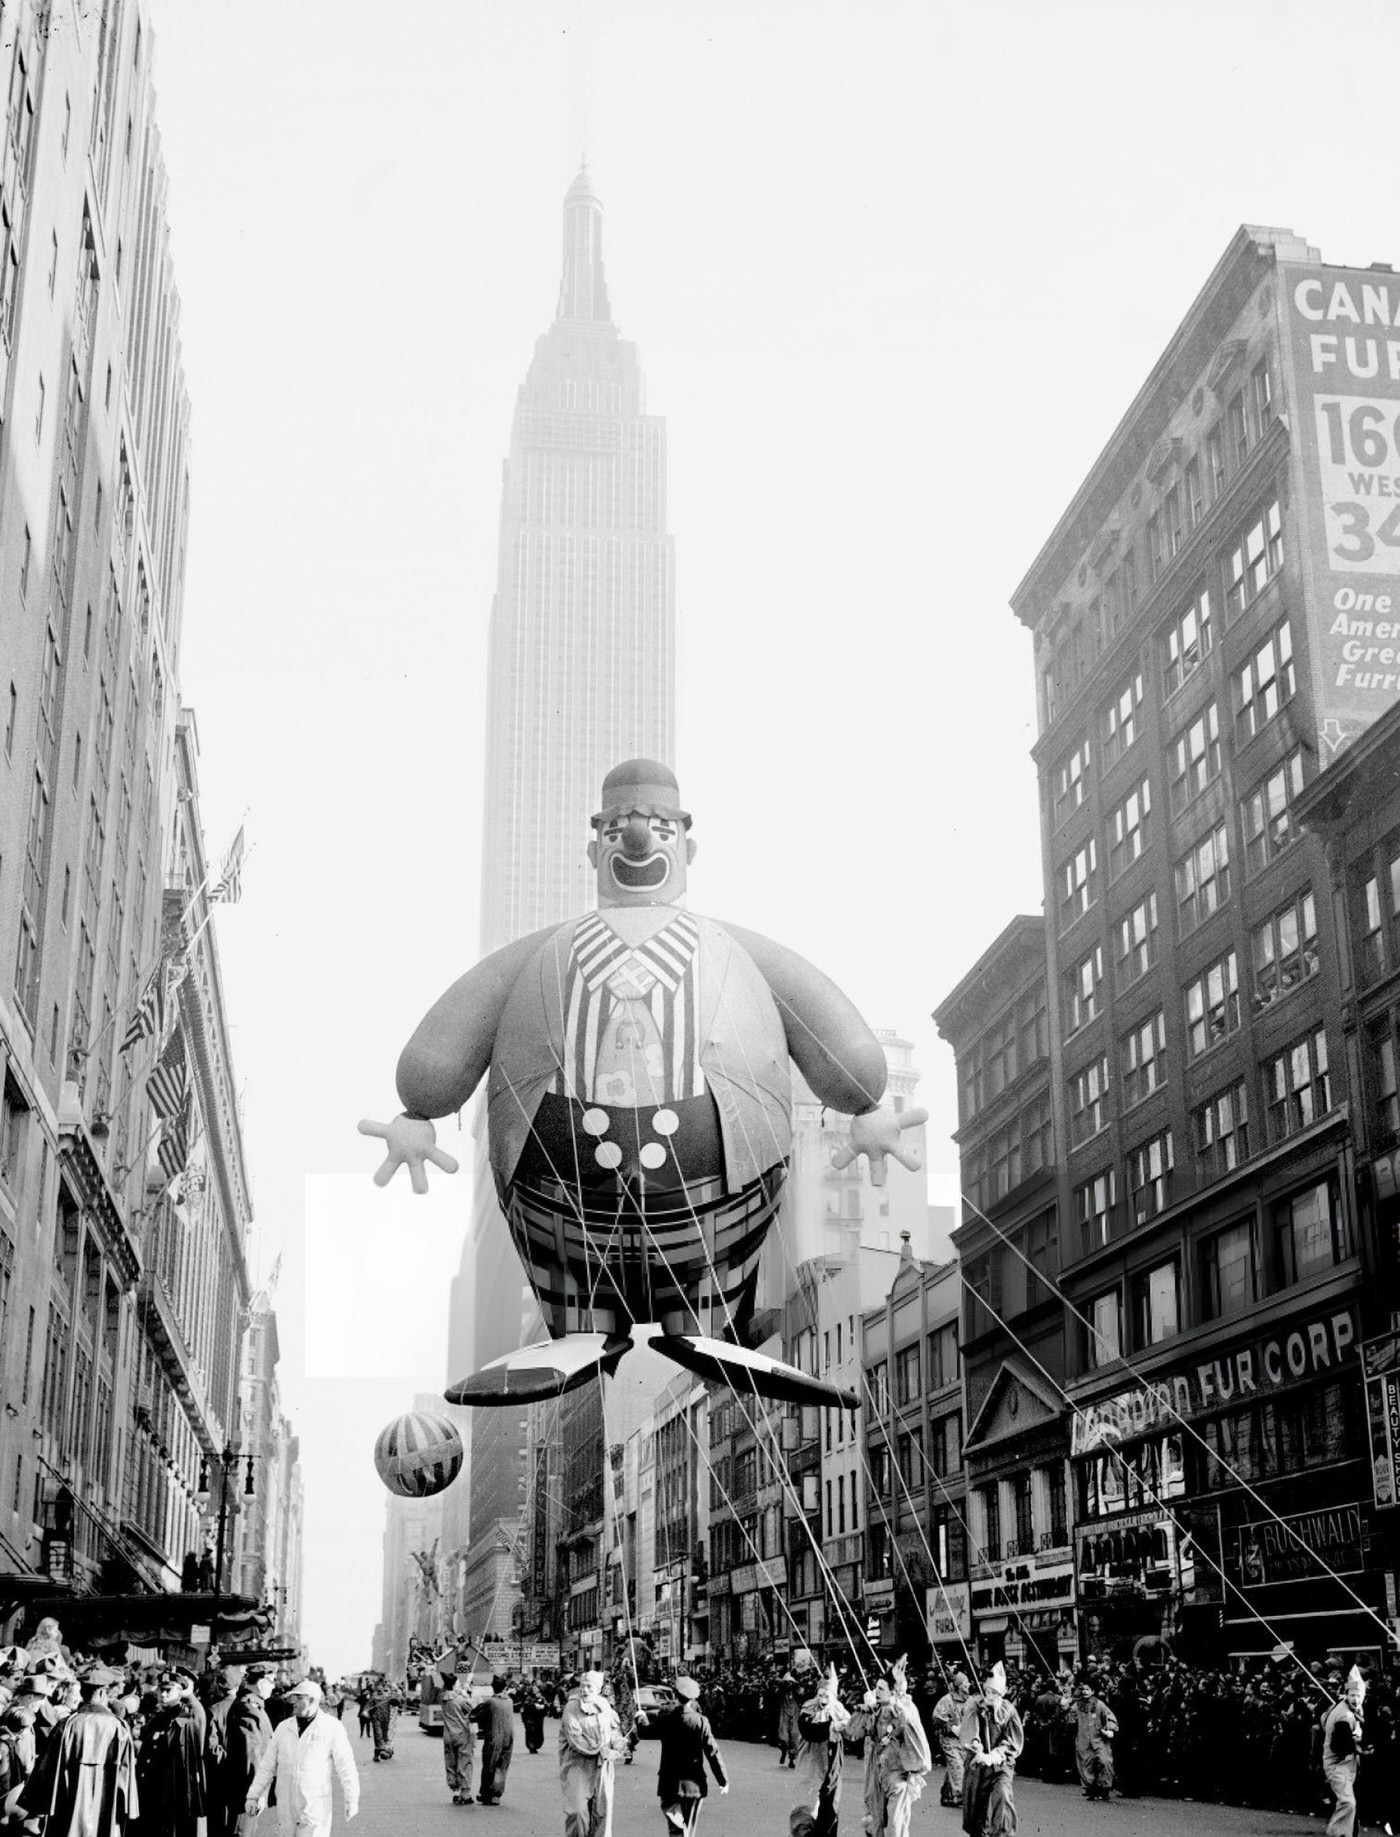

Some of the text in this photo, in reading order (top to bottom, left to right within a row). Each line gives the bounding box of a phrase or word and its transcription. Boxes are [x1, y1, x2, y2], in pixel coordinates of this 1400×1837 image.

[1294, 279, 1400, 327] CAN
[1321, 402, 1400, 468] 16
[1333, 588, 1392, 613] One
[1342, 640, 1400, 664] Gre
[1335, 664, 1400, 690] Furr
[1197, 1350, 1256, 1407] FUR
[1387, 1384, 1400, 1448] BEAUTY
[935, 1617, 956, 1634] FURS
